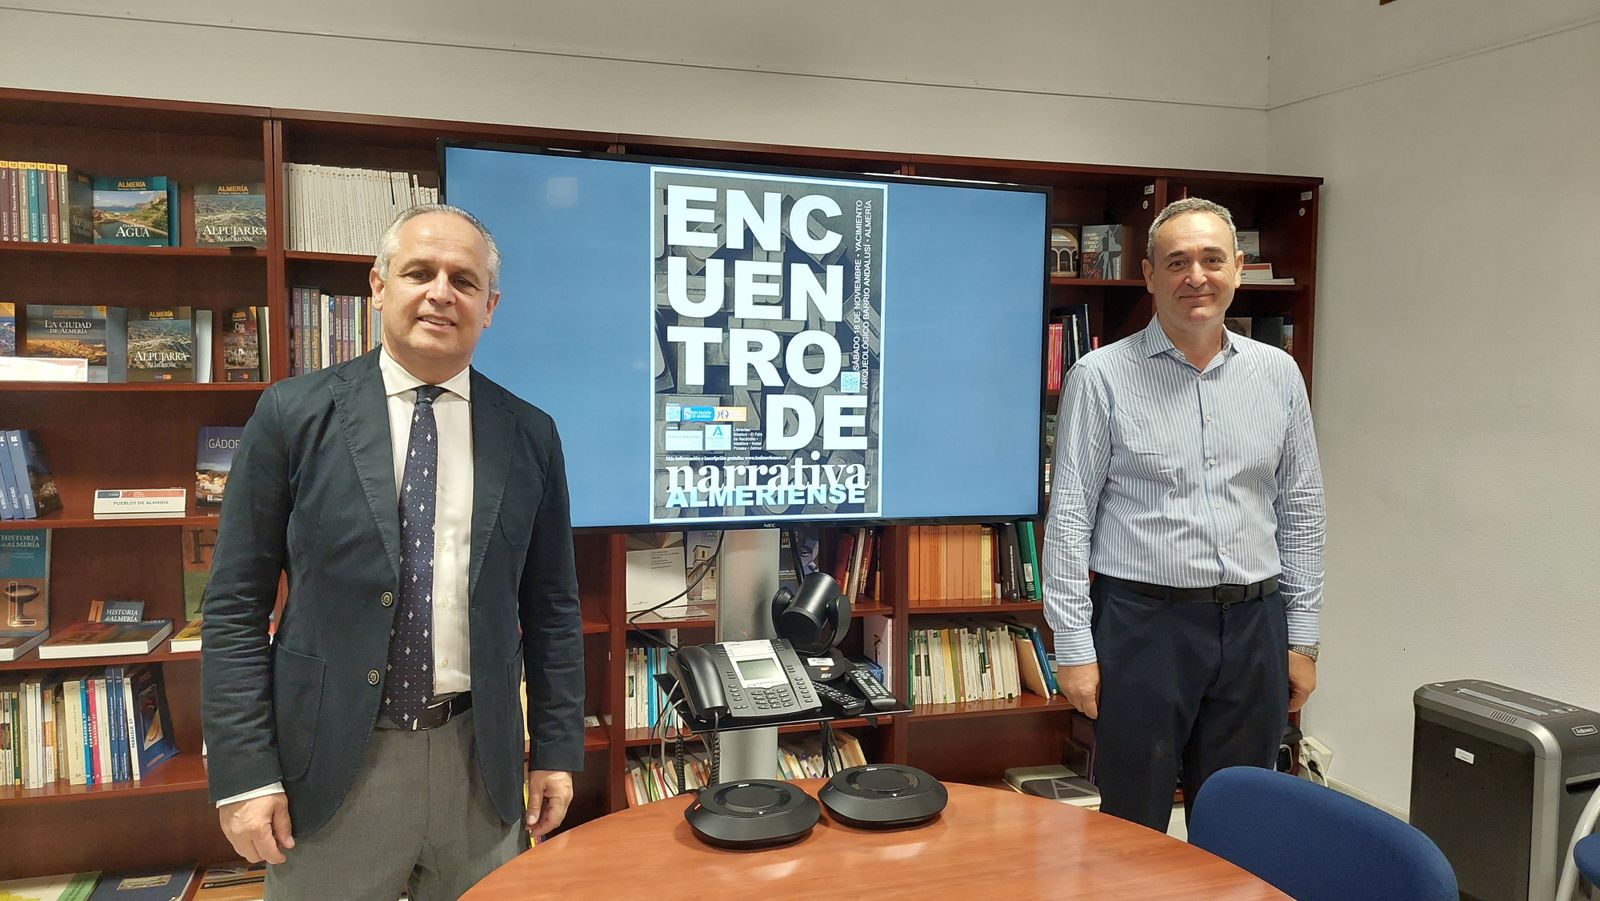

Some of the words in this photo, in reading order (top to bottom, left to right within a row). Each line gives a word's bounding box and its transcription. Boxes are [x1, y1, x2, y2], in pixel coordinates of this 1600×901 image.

[115, 226, 150, 238] AGUA
[202, 225, 267, 237] ALPUJARRA
[667, 184, 843, 255] ENC
[855, 200, 863, 252] YACIMIENTO
[864, 200, 872, 238] ALMERÍA
[863, 244, 871, 287] ANDALUSÍ
[667, 256, 844, 322] UEN
[854, 259, 862, 310] NOVIEMBRE
[854, 311, 861, 323] DE
[862, 288, 870, 320] BARRIO
[44, 319, 58, 328] LA
[59, 321, 92, 329] CIUDAD
[60, 327, 88, 335] ALMERÍA
[853, 324, 861, 334] 18
[134, 350, 188, 364] ALPUJARRA
[667, 325, 842, 388] TRO
[852, 336, 861, 371] SÁBADO
[861, 322, 870, 389] ARQUEOLÓGICO
[766, 394, 867, 450] DE
[665, 450, 870, 493] narrativa
[665, 483, 866, 509] ALMERIENSE
[7, 540, 41, 548] ALMERÍA
[106, 608, 138, 616] HISTORIA
[109, 614, 138, 623] ALMERÍA
